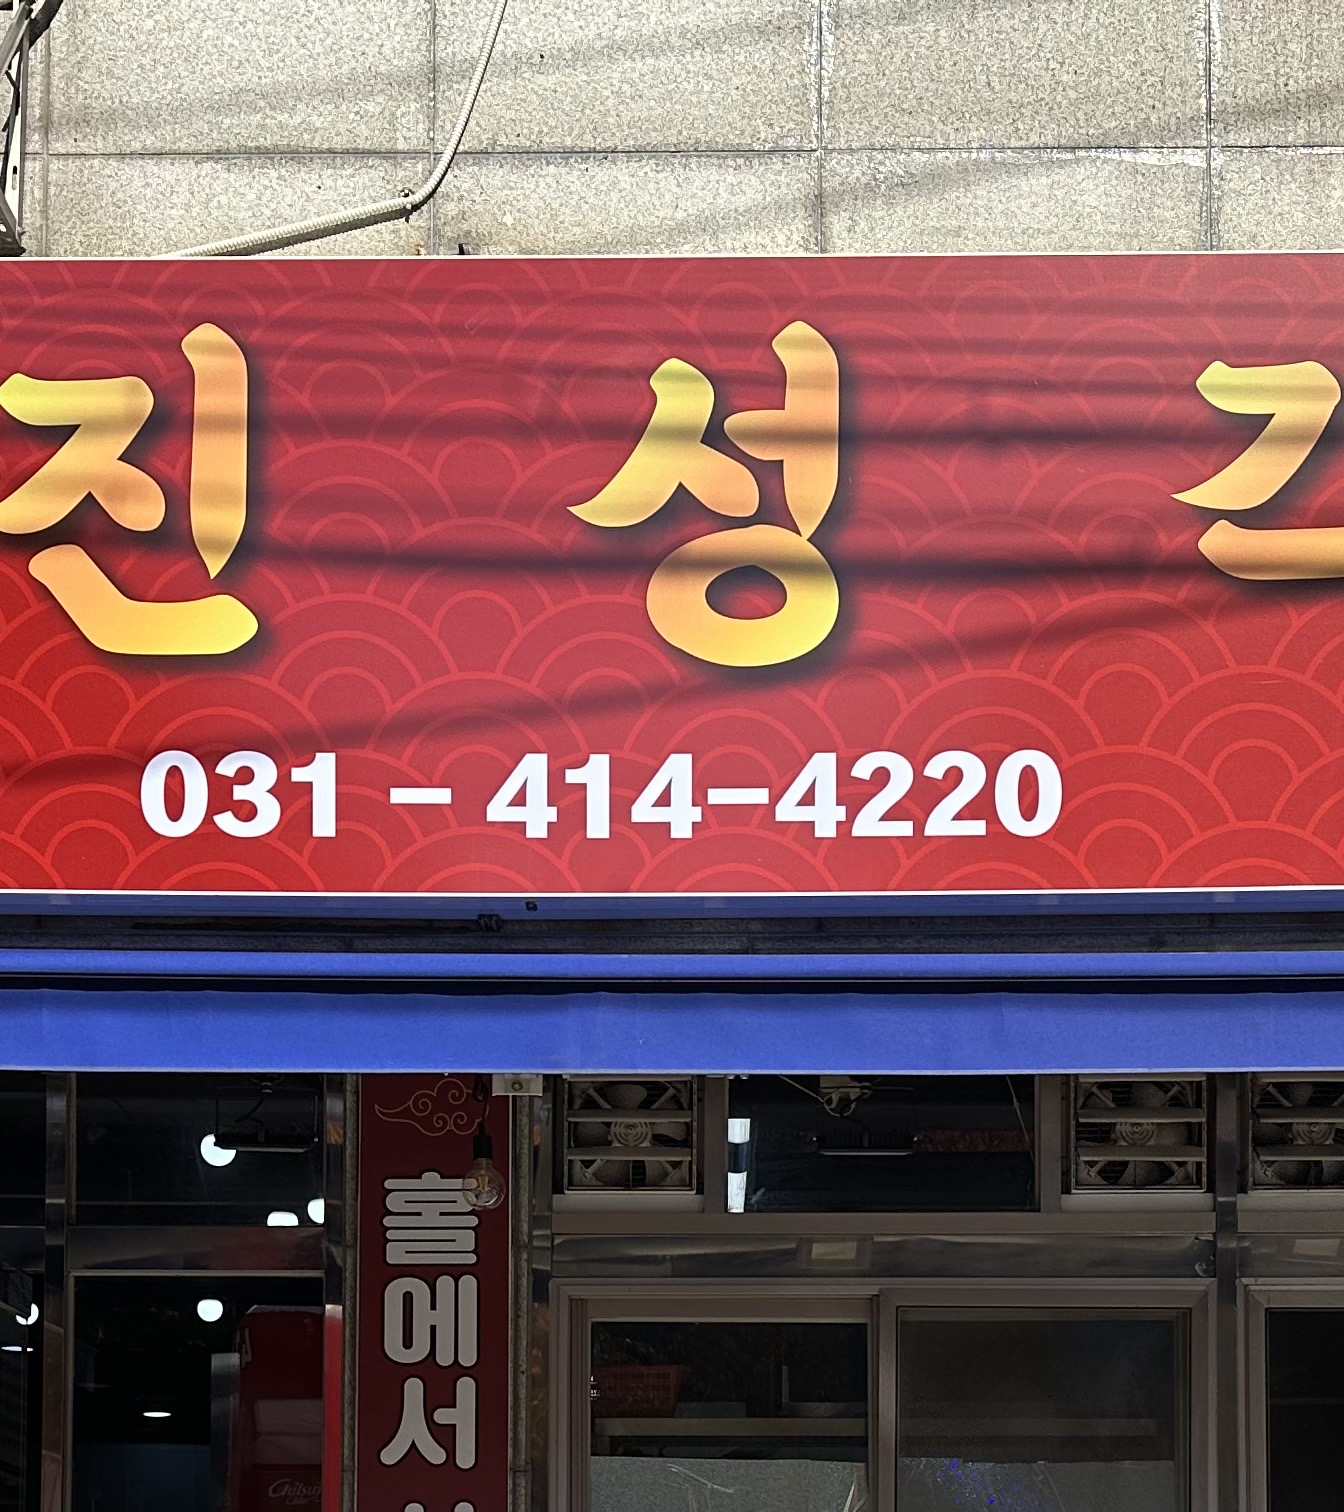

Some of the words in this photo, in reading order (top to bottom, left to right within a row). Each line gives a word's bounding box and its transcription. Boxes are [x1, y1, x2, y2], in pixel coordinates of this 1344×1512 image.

[140, 750, 339, 838] 031
[486, 749, 1063, 839] 414-4220
[378, 1171, 479, 1470] 홀에서
